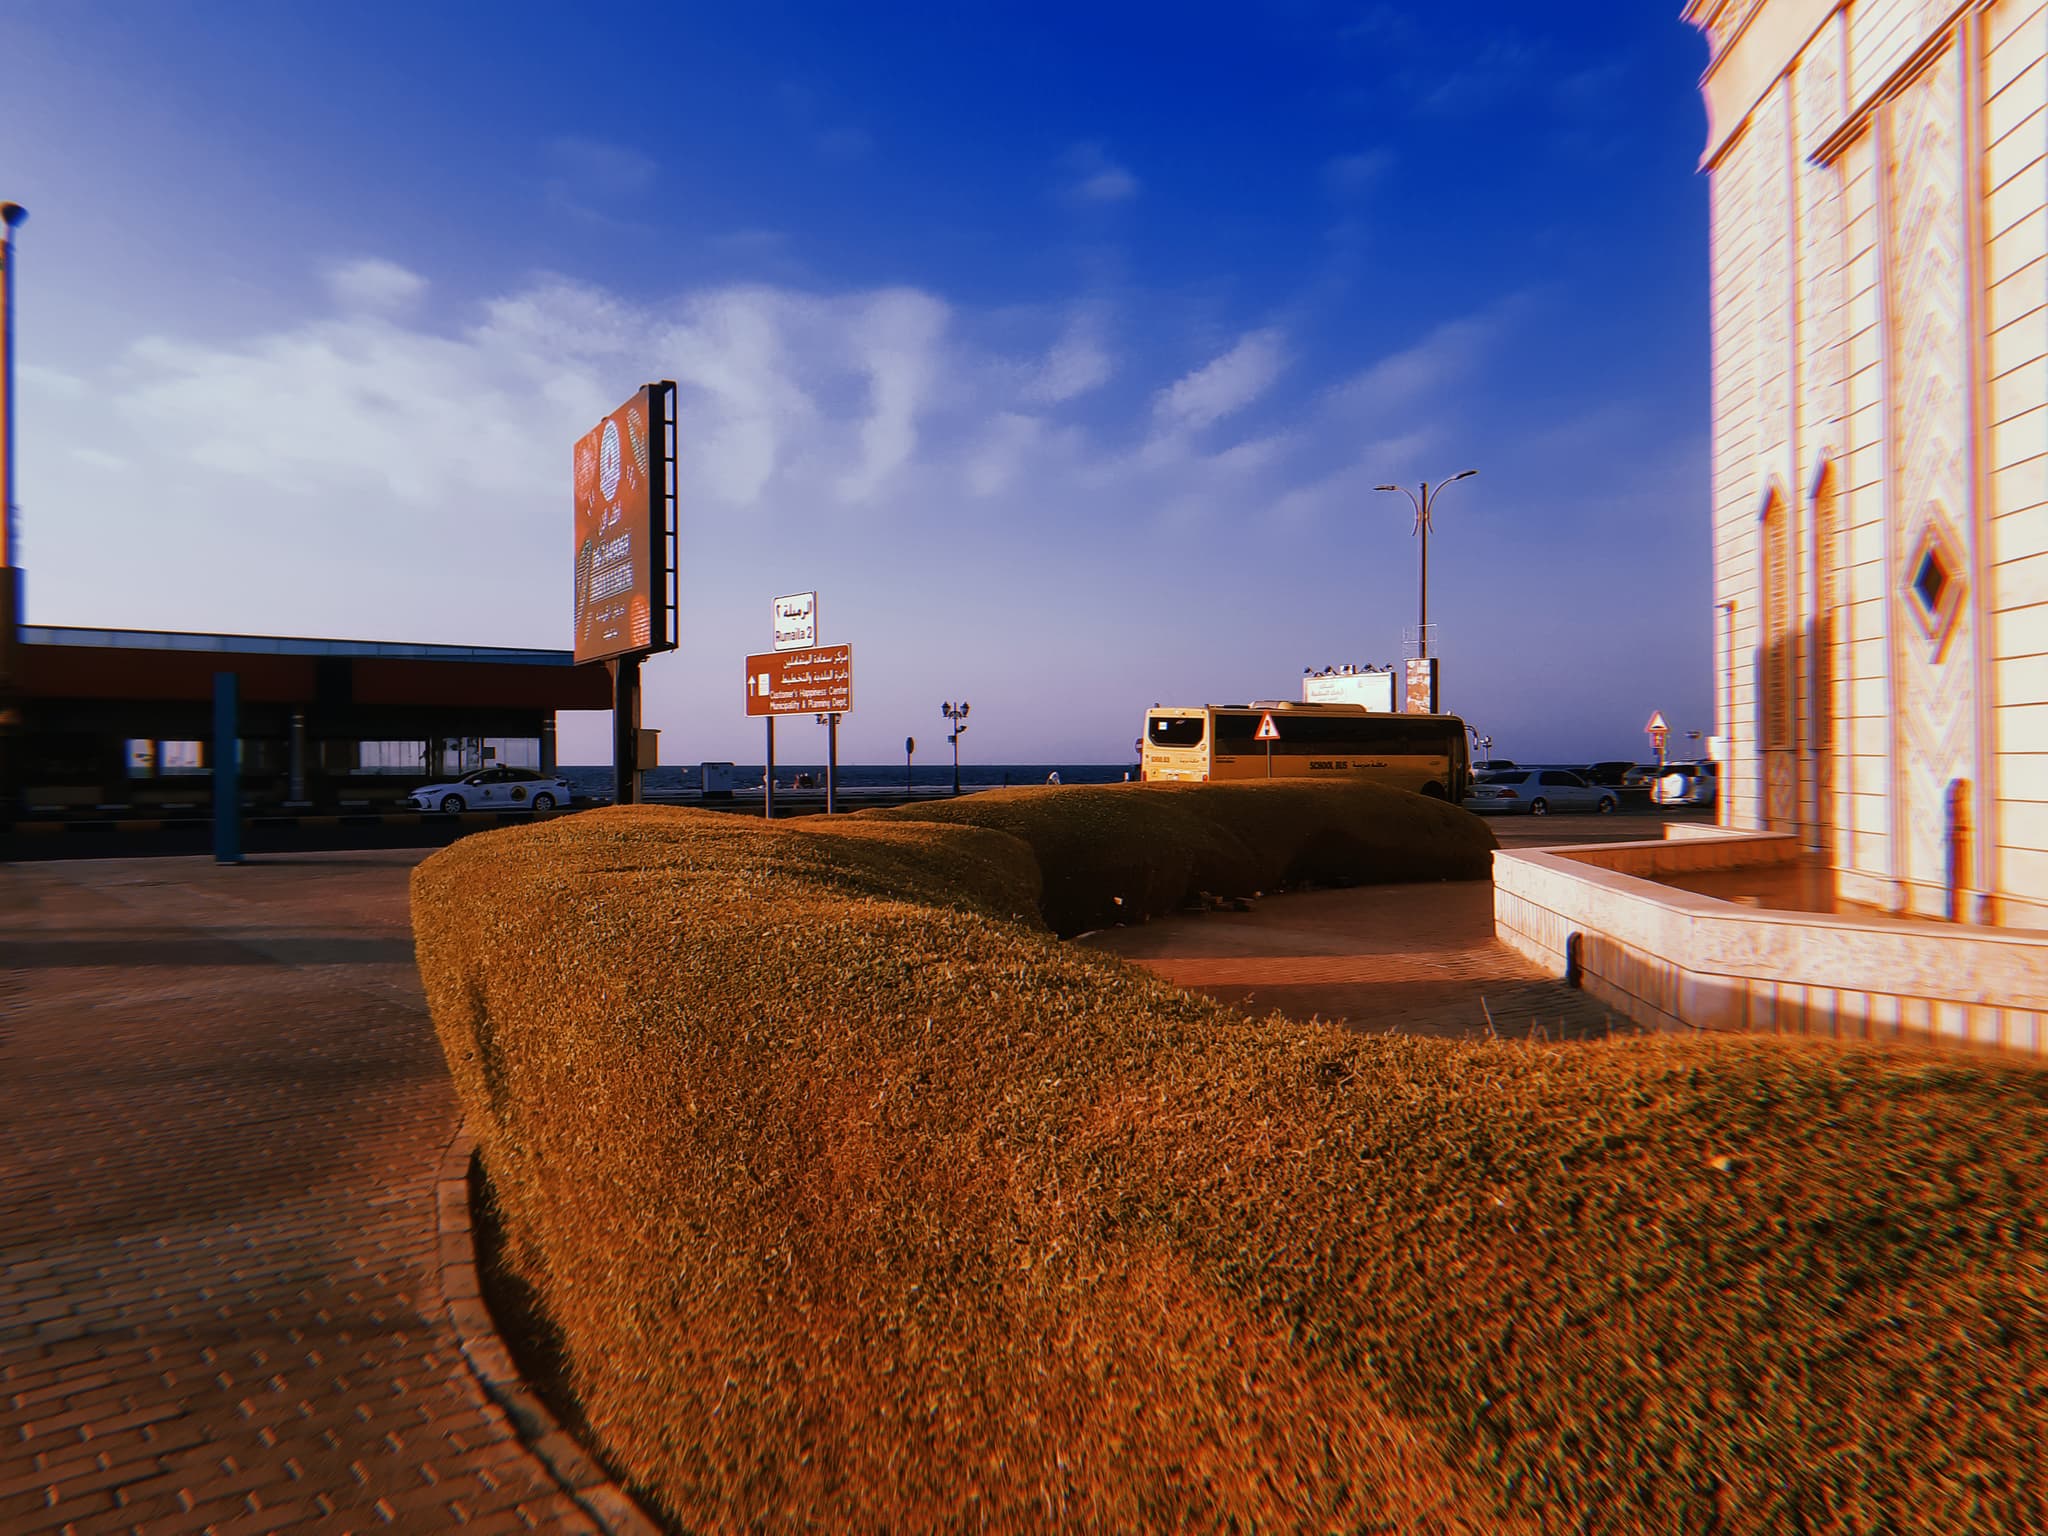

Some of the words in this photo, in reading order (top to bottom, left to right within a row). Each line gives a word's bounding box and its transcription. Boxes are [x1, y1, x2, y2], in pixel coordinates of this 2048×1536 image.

[784, 600, 813, 620] الرميلة
[775, 628, 805, 643] Rumaila
[807, 626, 813, 639] 2
[813, 652, 833, 664] سعادة
[834, 651, 848, 665] مركز
[781, 671, 813, 685] والتخطيط
[813, 670, 833, 683] البلدية
[834, 668, 848, 682] دائرة
[800, 687, 827, 698] Happiness
[770, 701, 800, 711] Municipality
[808, 699, 831, 709] Planning
[1309, 761, 1334, 770] SCHOOL
[1335, 761, 1348, 770] BUS
